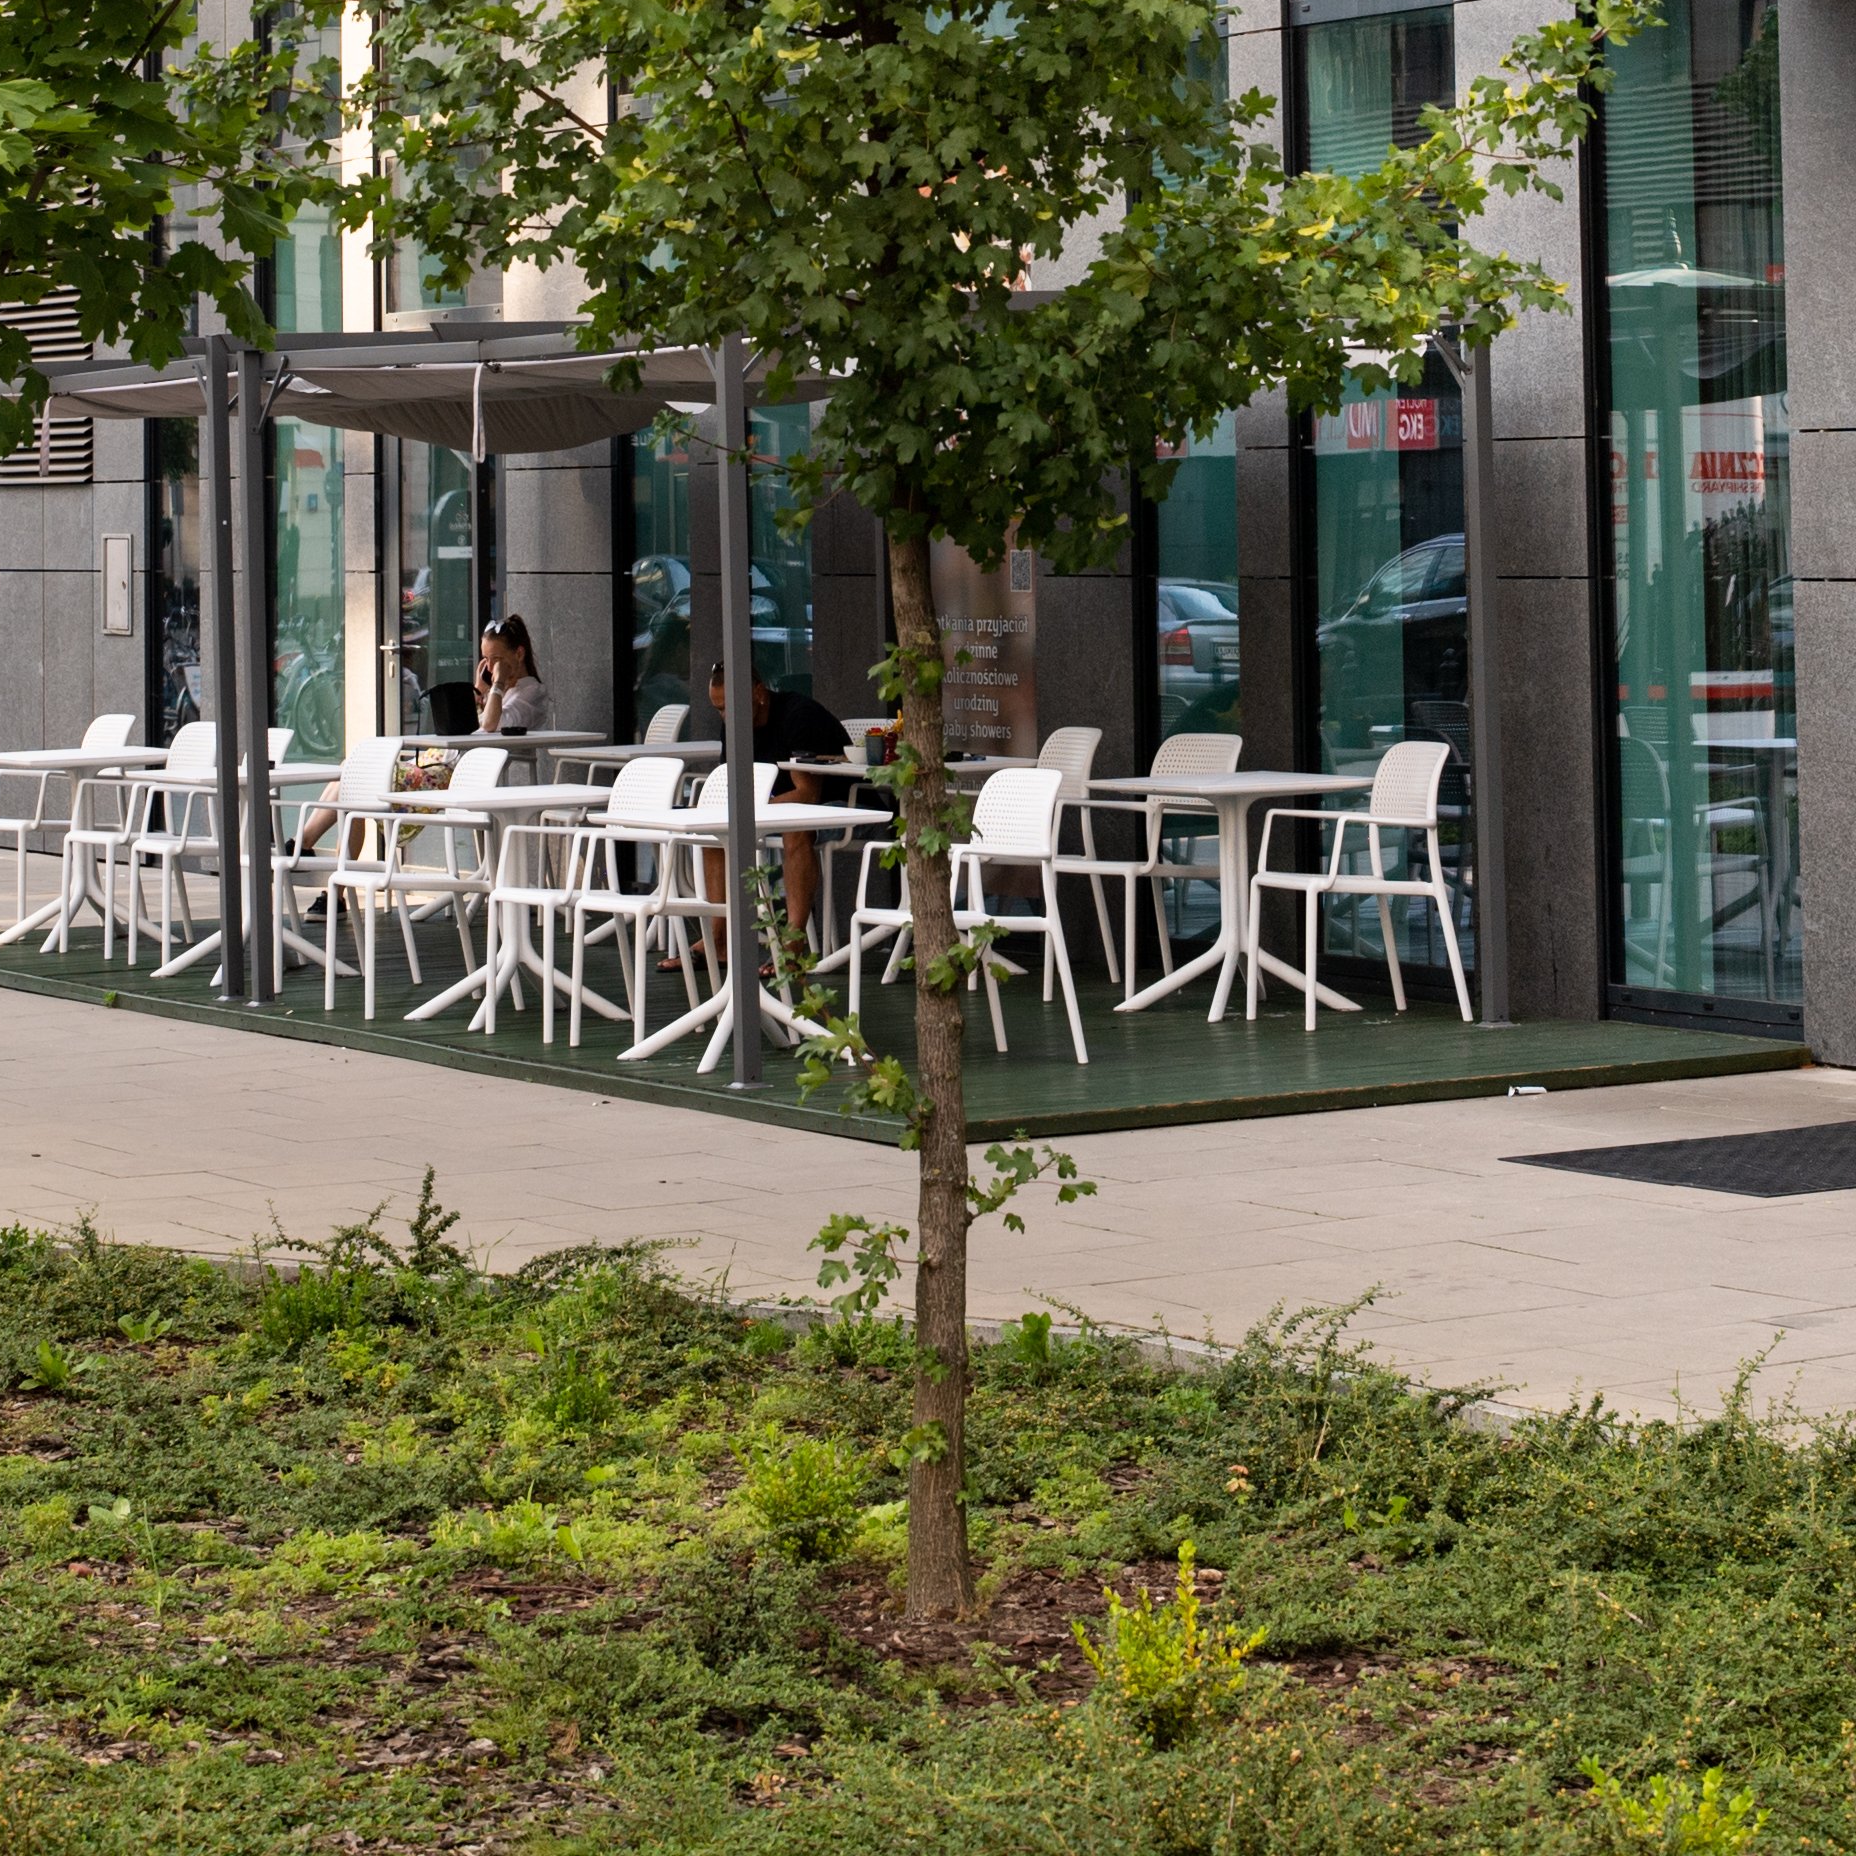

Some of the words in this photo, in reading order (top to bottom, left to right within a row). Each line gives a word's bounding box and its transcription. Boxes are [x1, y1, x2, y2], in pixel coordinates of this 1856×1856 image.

[976, 614, 1029, 638] przyjaciół
[954, 694, 999, 717] urodziny
[969, 720, 1012, 739] showers
